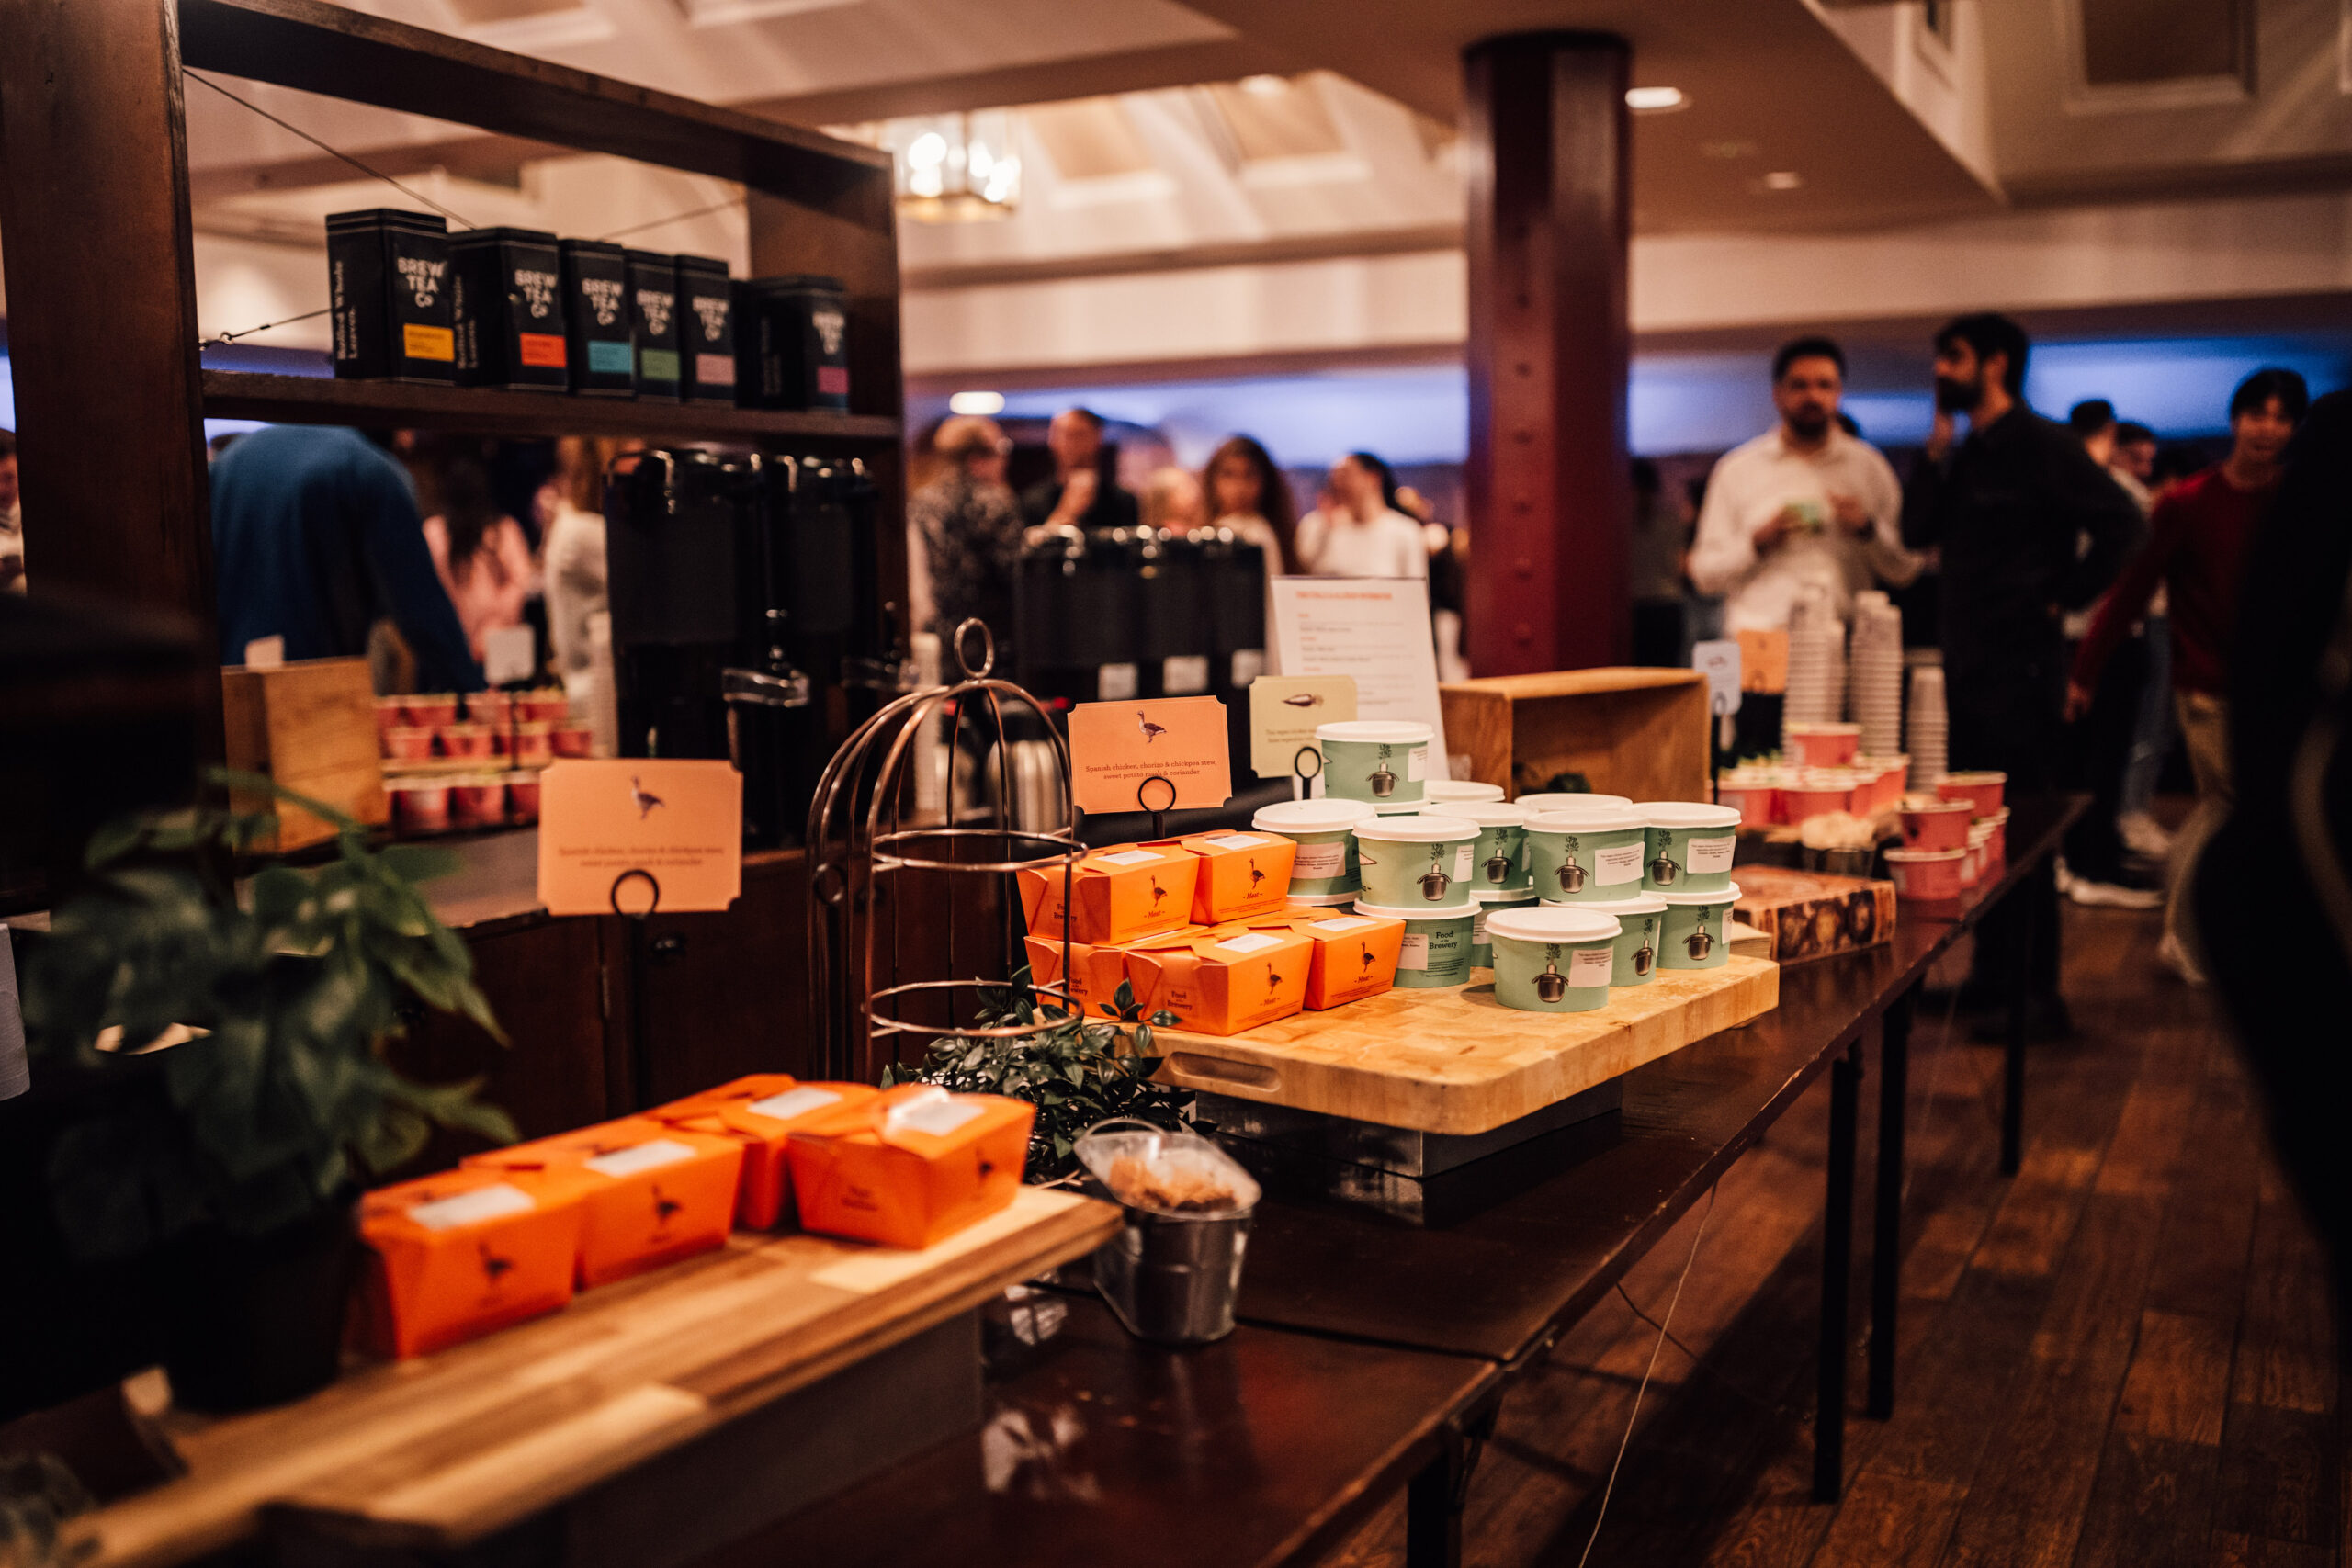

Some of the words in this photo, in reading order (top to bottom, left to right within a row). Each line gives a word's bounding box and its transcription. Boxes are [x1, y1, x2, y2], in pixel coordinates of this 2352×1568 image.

[398, 257, 447, 278] BREW
[406, 275, 439, 293] TEA
[514, 269, 558, 288] BREW
[523, 286, 553, 304] TEA
[1085, 764, 1111, 773] Spanish
[1170, 760, 1200, 769] chickpea
[1123, 772, 1144, 780] potato
[1170, 768, 1200, 776] coriander
[1435, 931, 1453, 939] Food
[1429, 942, 1458, 950] Brewery
